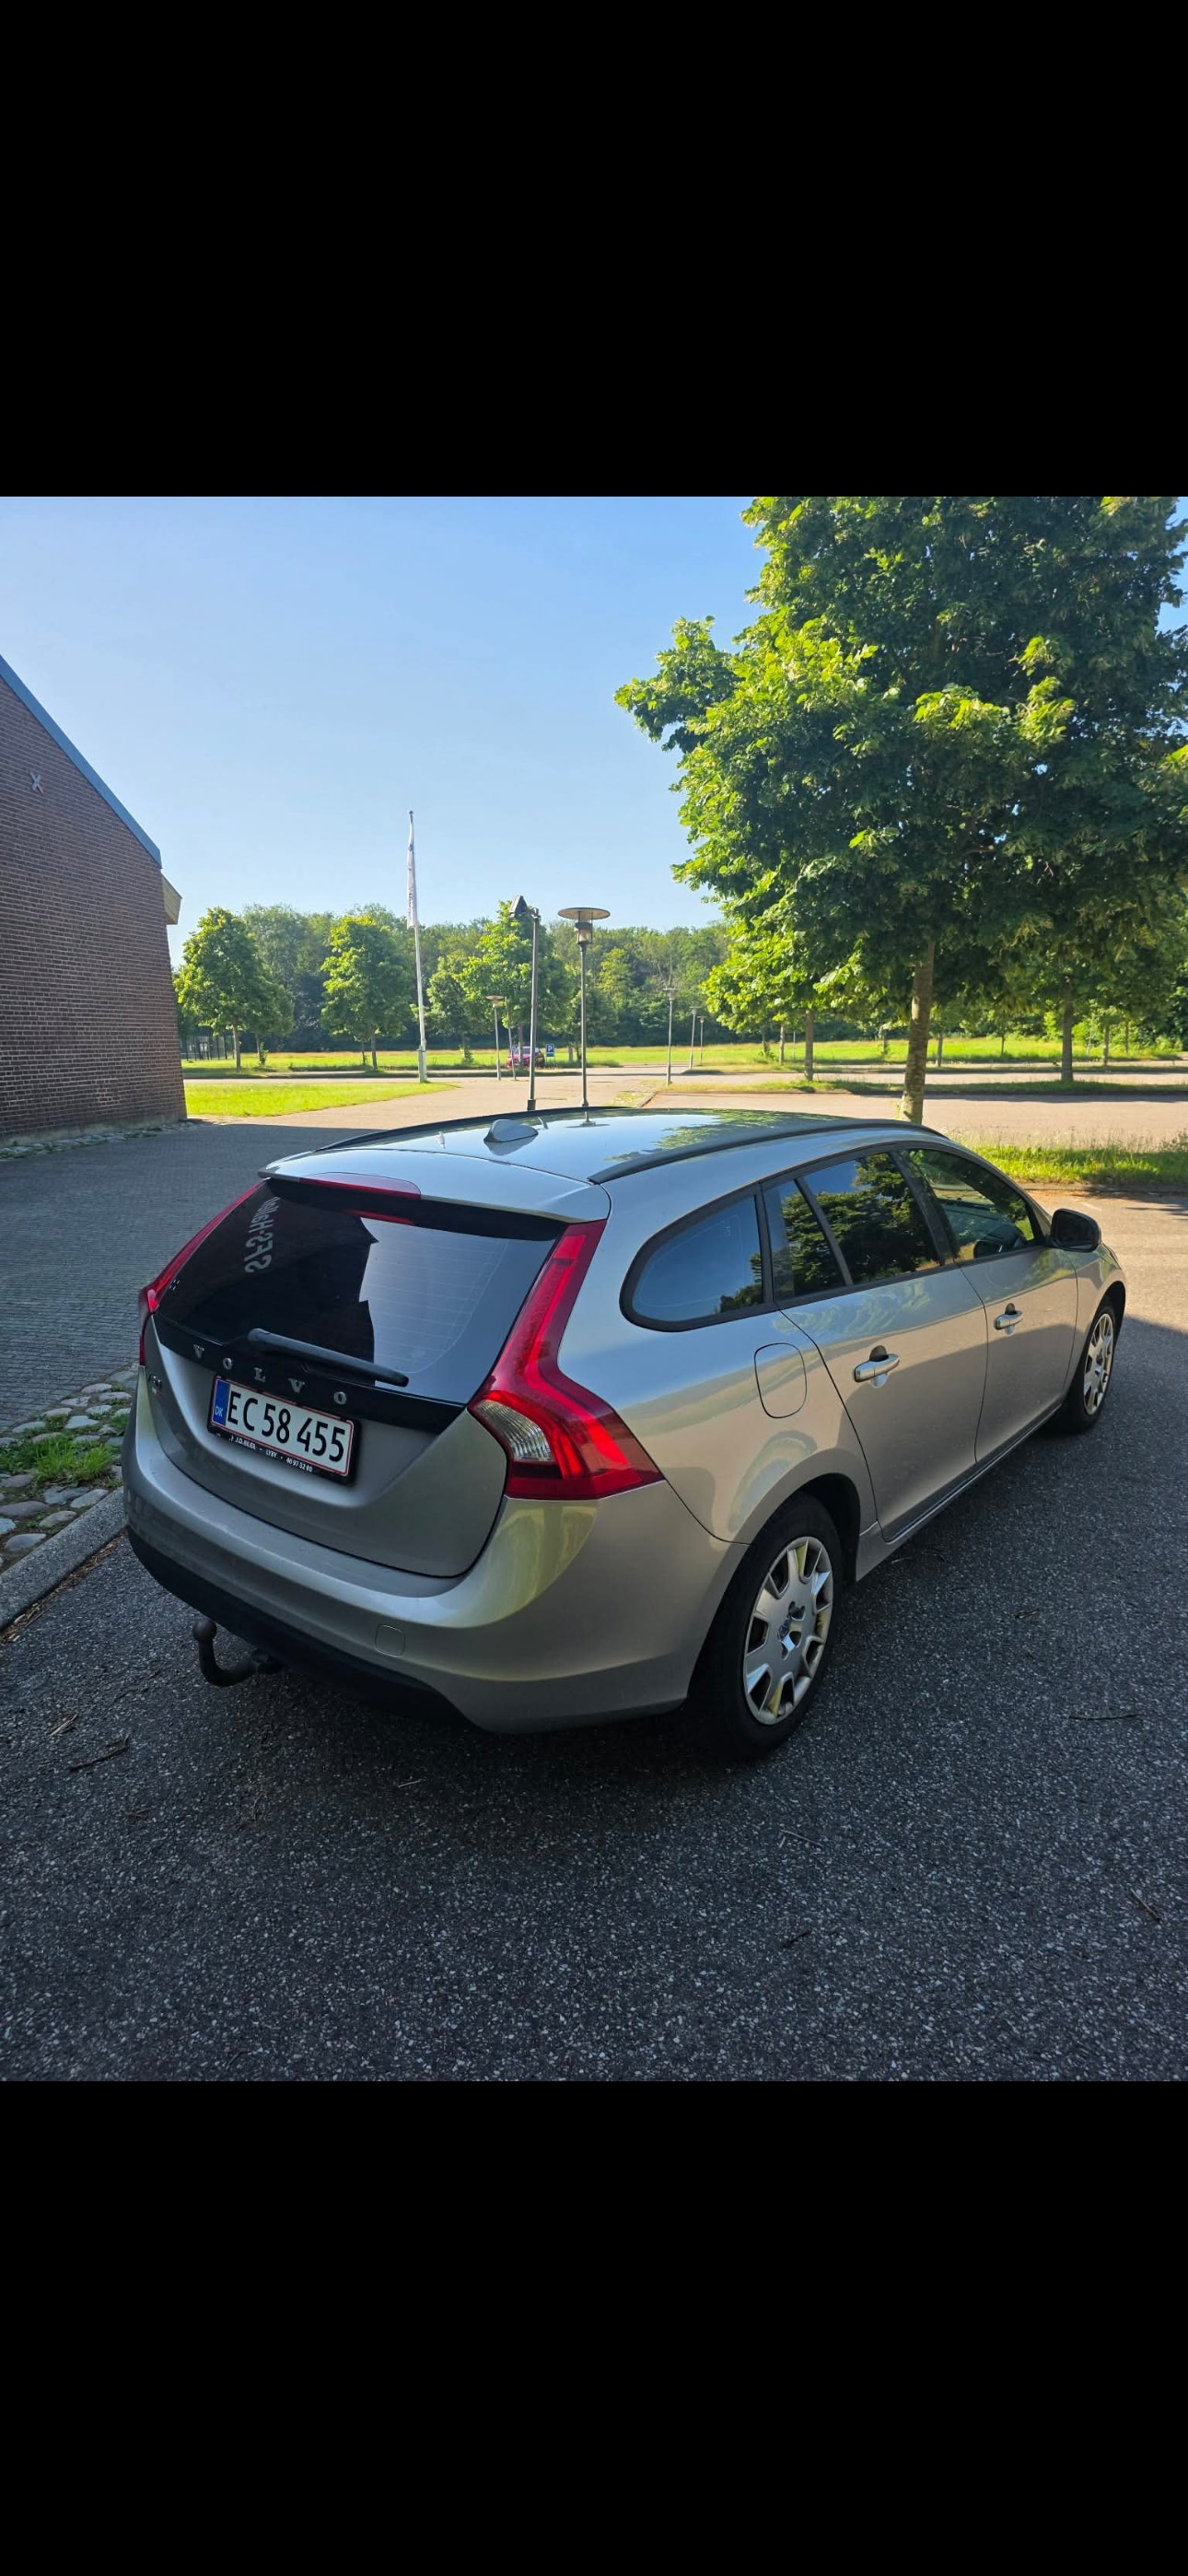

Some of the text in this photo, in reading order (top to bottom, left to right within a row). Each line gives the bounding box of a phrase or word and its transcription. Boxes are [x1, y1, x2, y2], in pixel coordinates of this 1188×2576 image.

[193, 1344, 347, 1406] VOLVO
[215, 1406, 223, 1417] DK
[227, 1390, 346, 1462] EC 58 455
